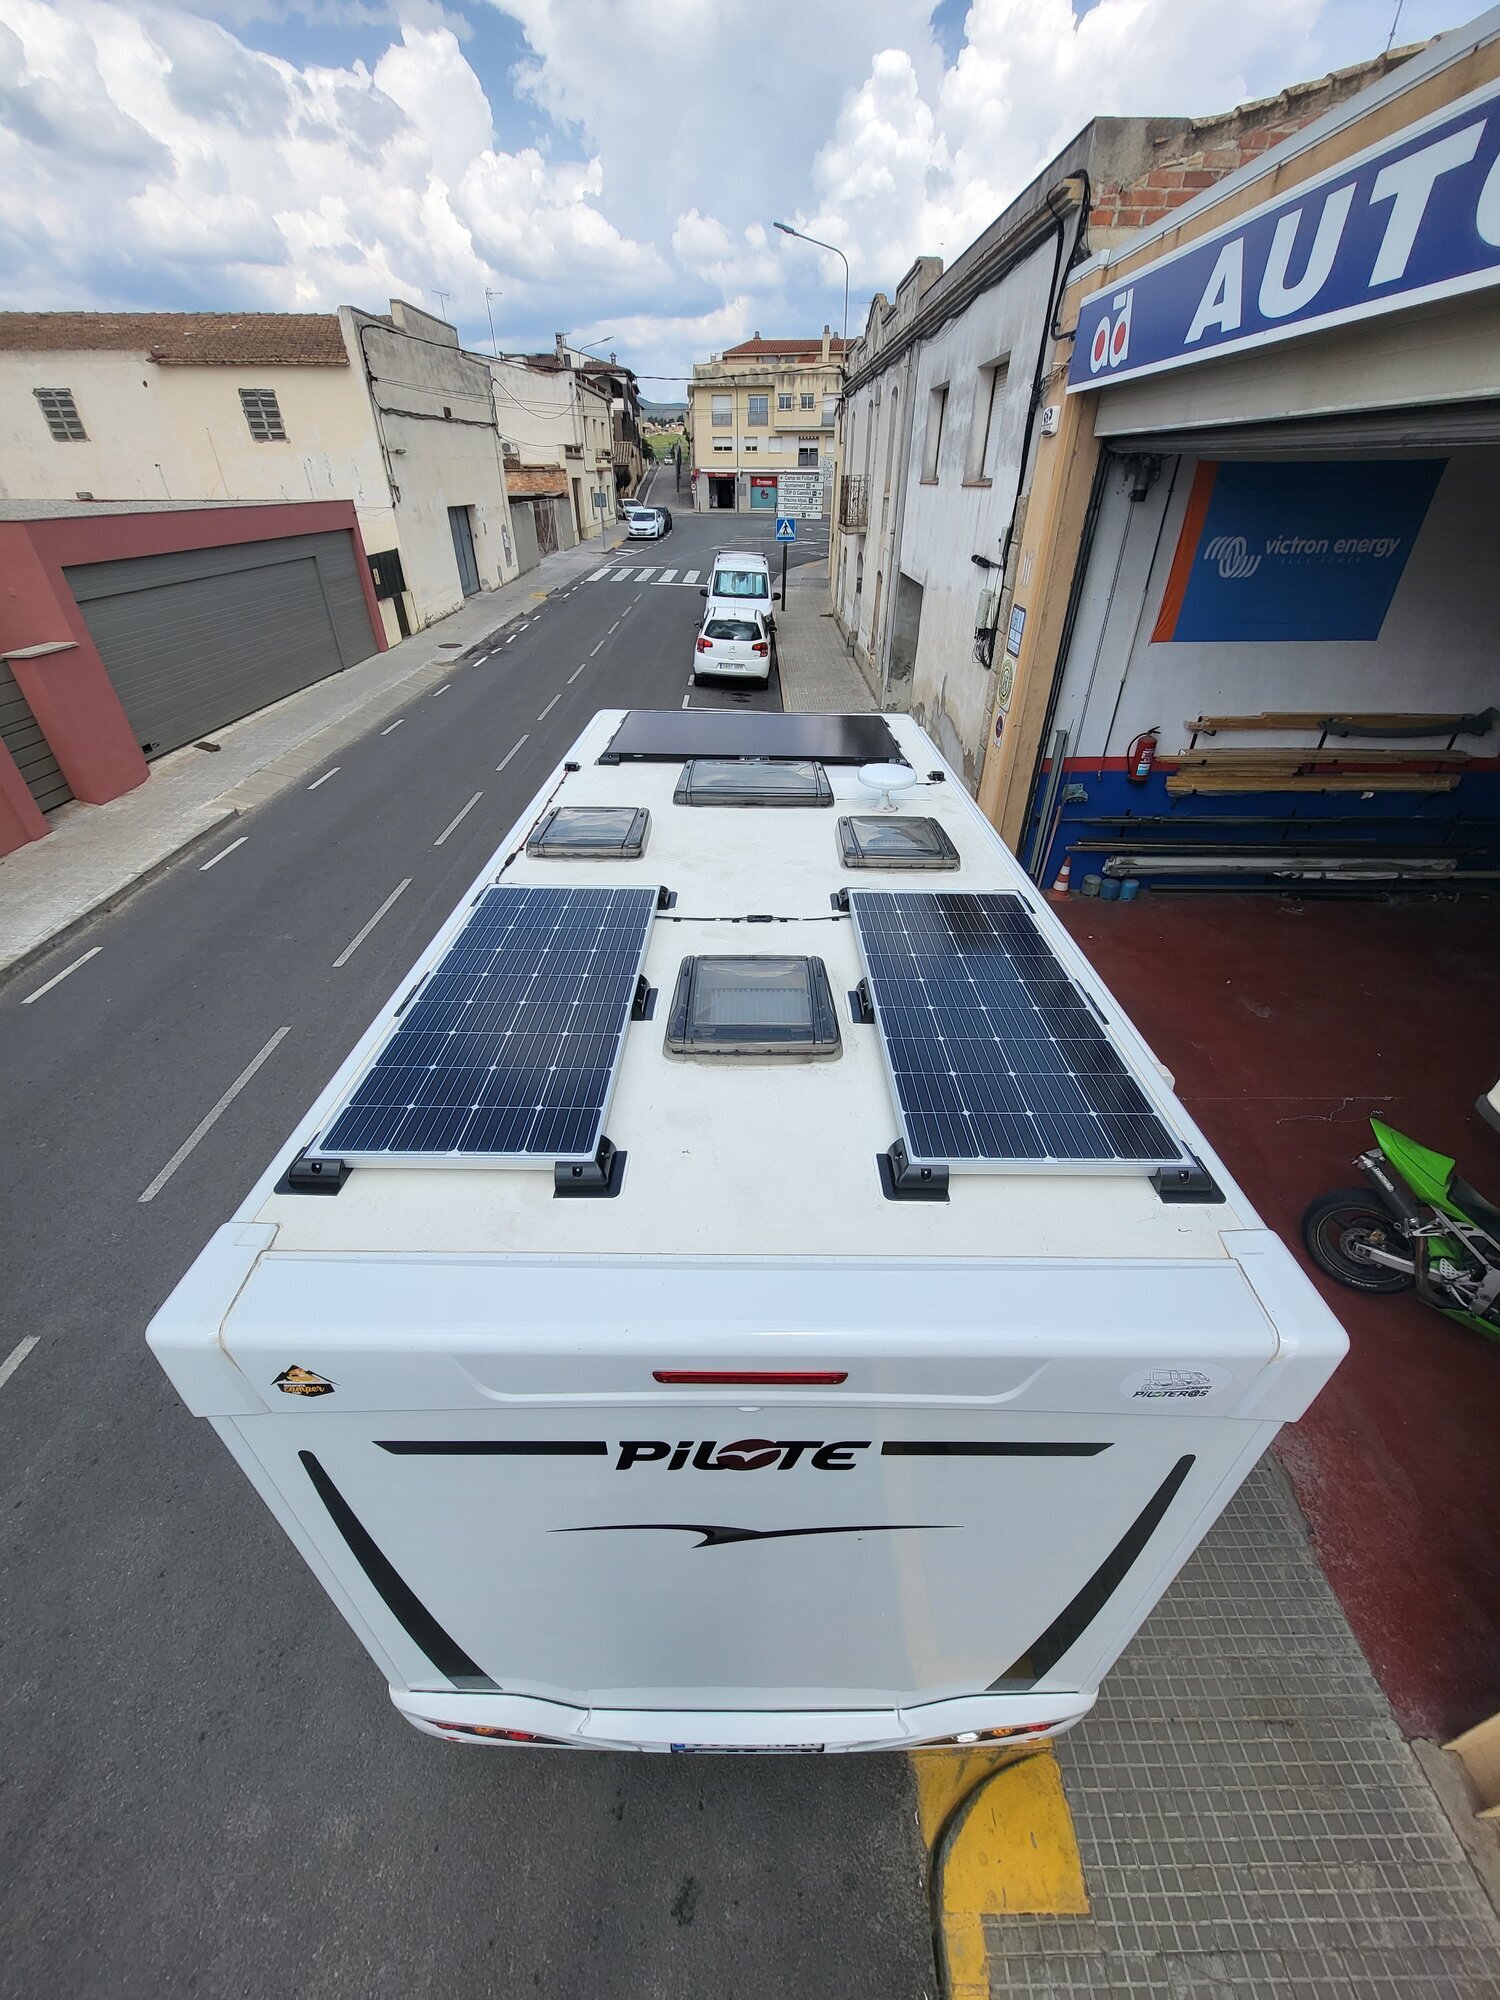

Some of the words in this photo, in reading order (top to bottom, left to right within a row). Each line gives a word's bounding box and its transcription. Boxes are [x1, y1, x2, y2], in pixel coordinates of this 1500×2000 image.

[1265, 534, 1329, 554] victron
[1333, 537, 1401, 558] energy
[284, 1386, 325, 1395] camper
